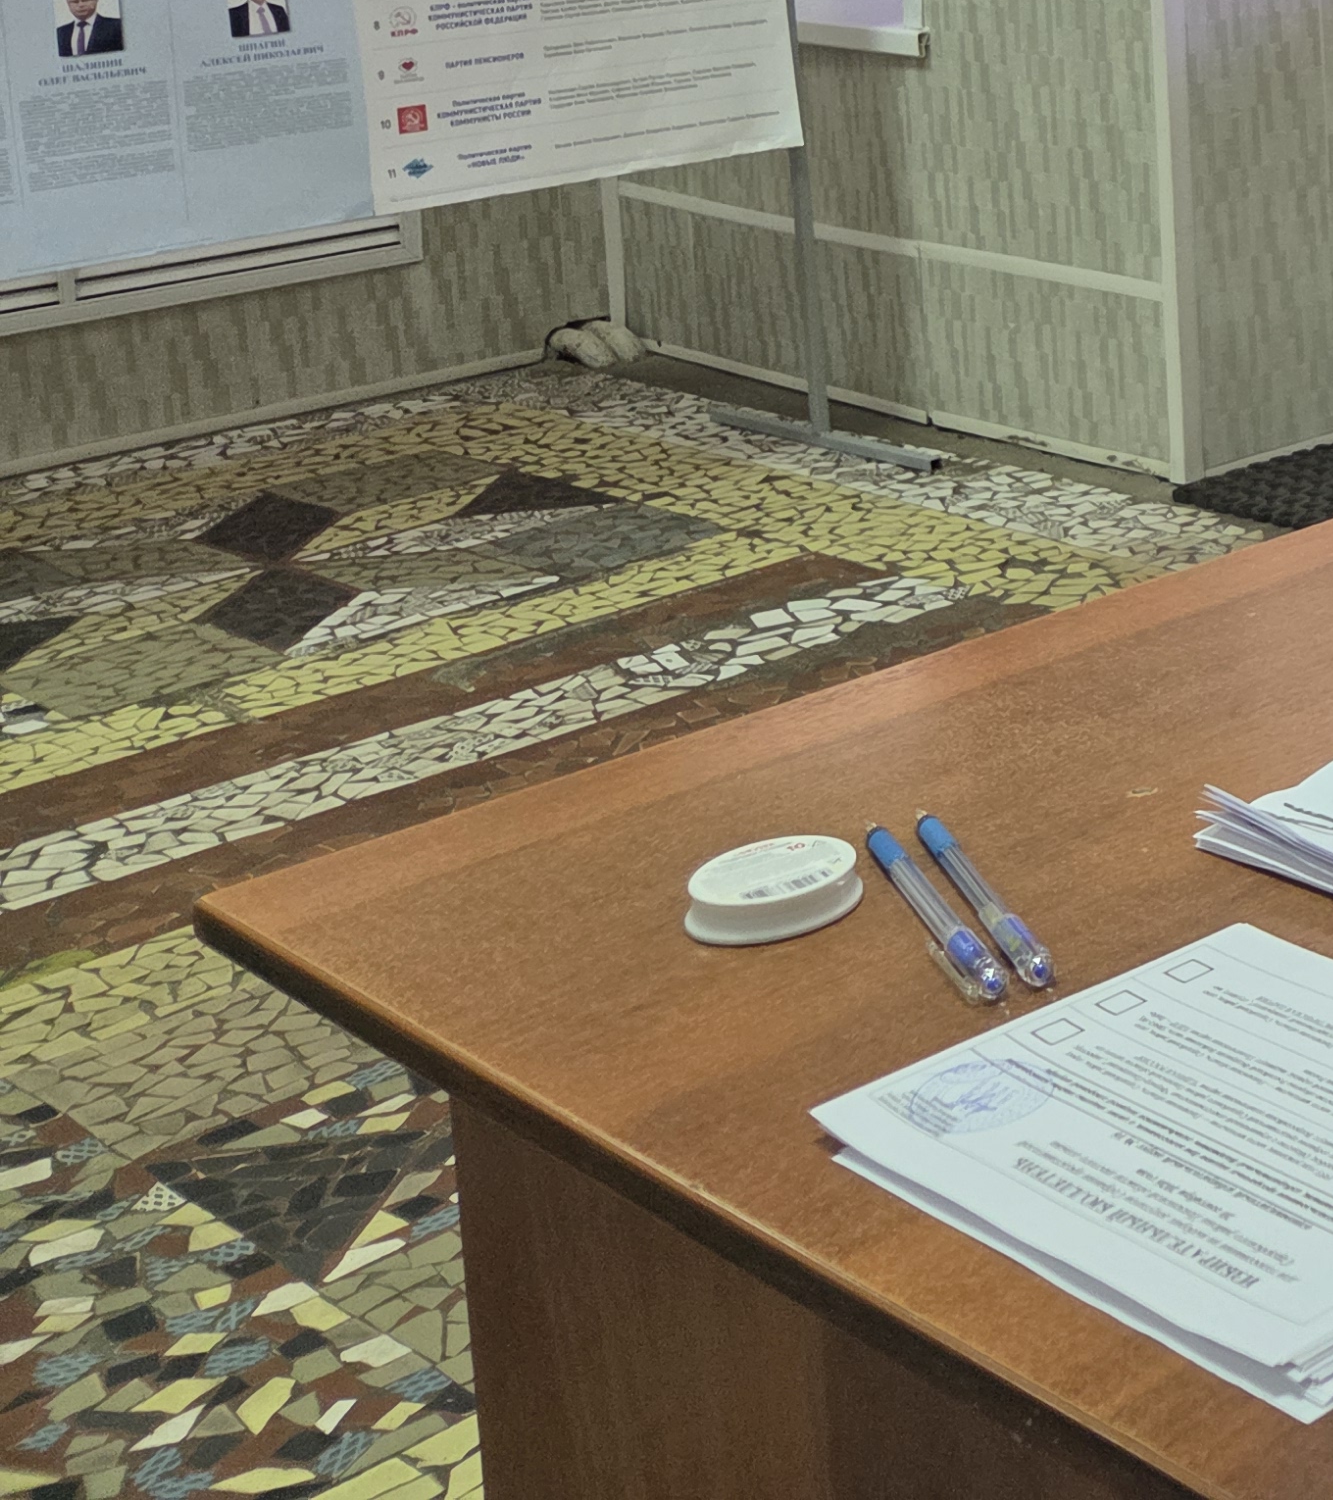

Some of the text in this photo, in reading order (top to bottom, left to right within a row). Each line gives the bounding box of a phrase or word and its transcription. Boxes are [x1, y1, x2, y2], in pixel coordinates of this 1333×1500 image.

[373, 20, 380, 31] 8
[390, 28, 419, 38] КПРФ
[378, 69, 385, 80] 9
[380, 120, 391, 130] 10
[388, 169, 397, 178] 11
[1004, 1156, 1262, 1289] ИЗБИРАТЕЛЬНЫЙ БЮЛЛЕТЕНЬ
